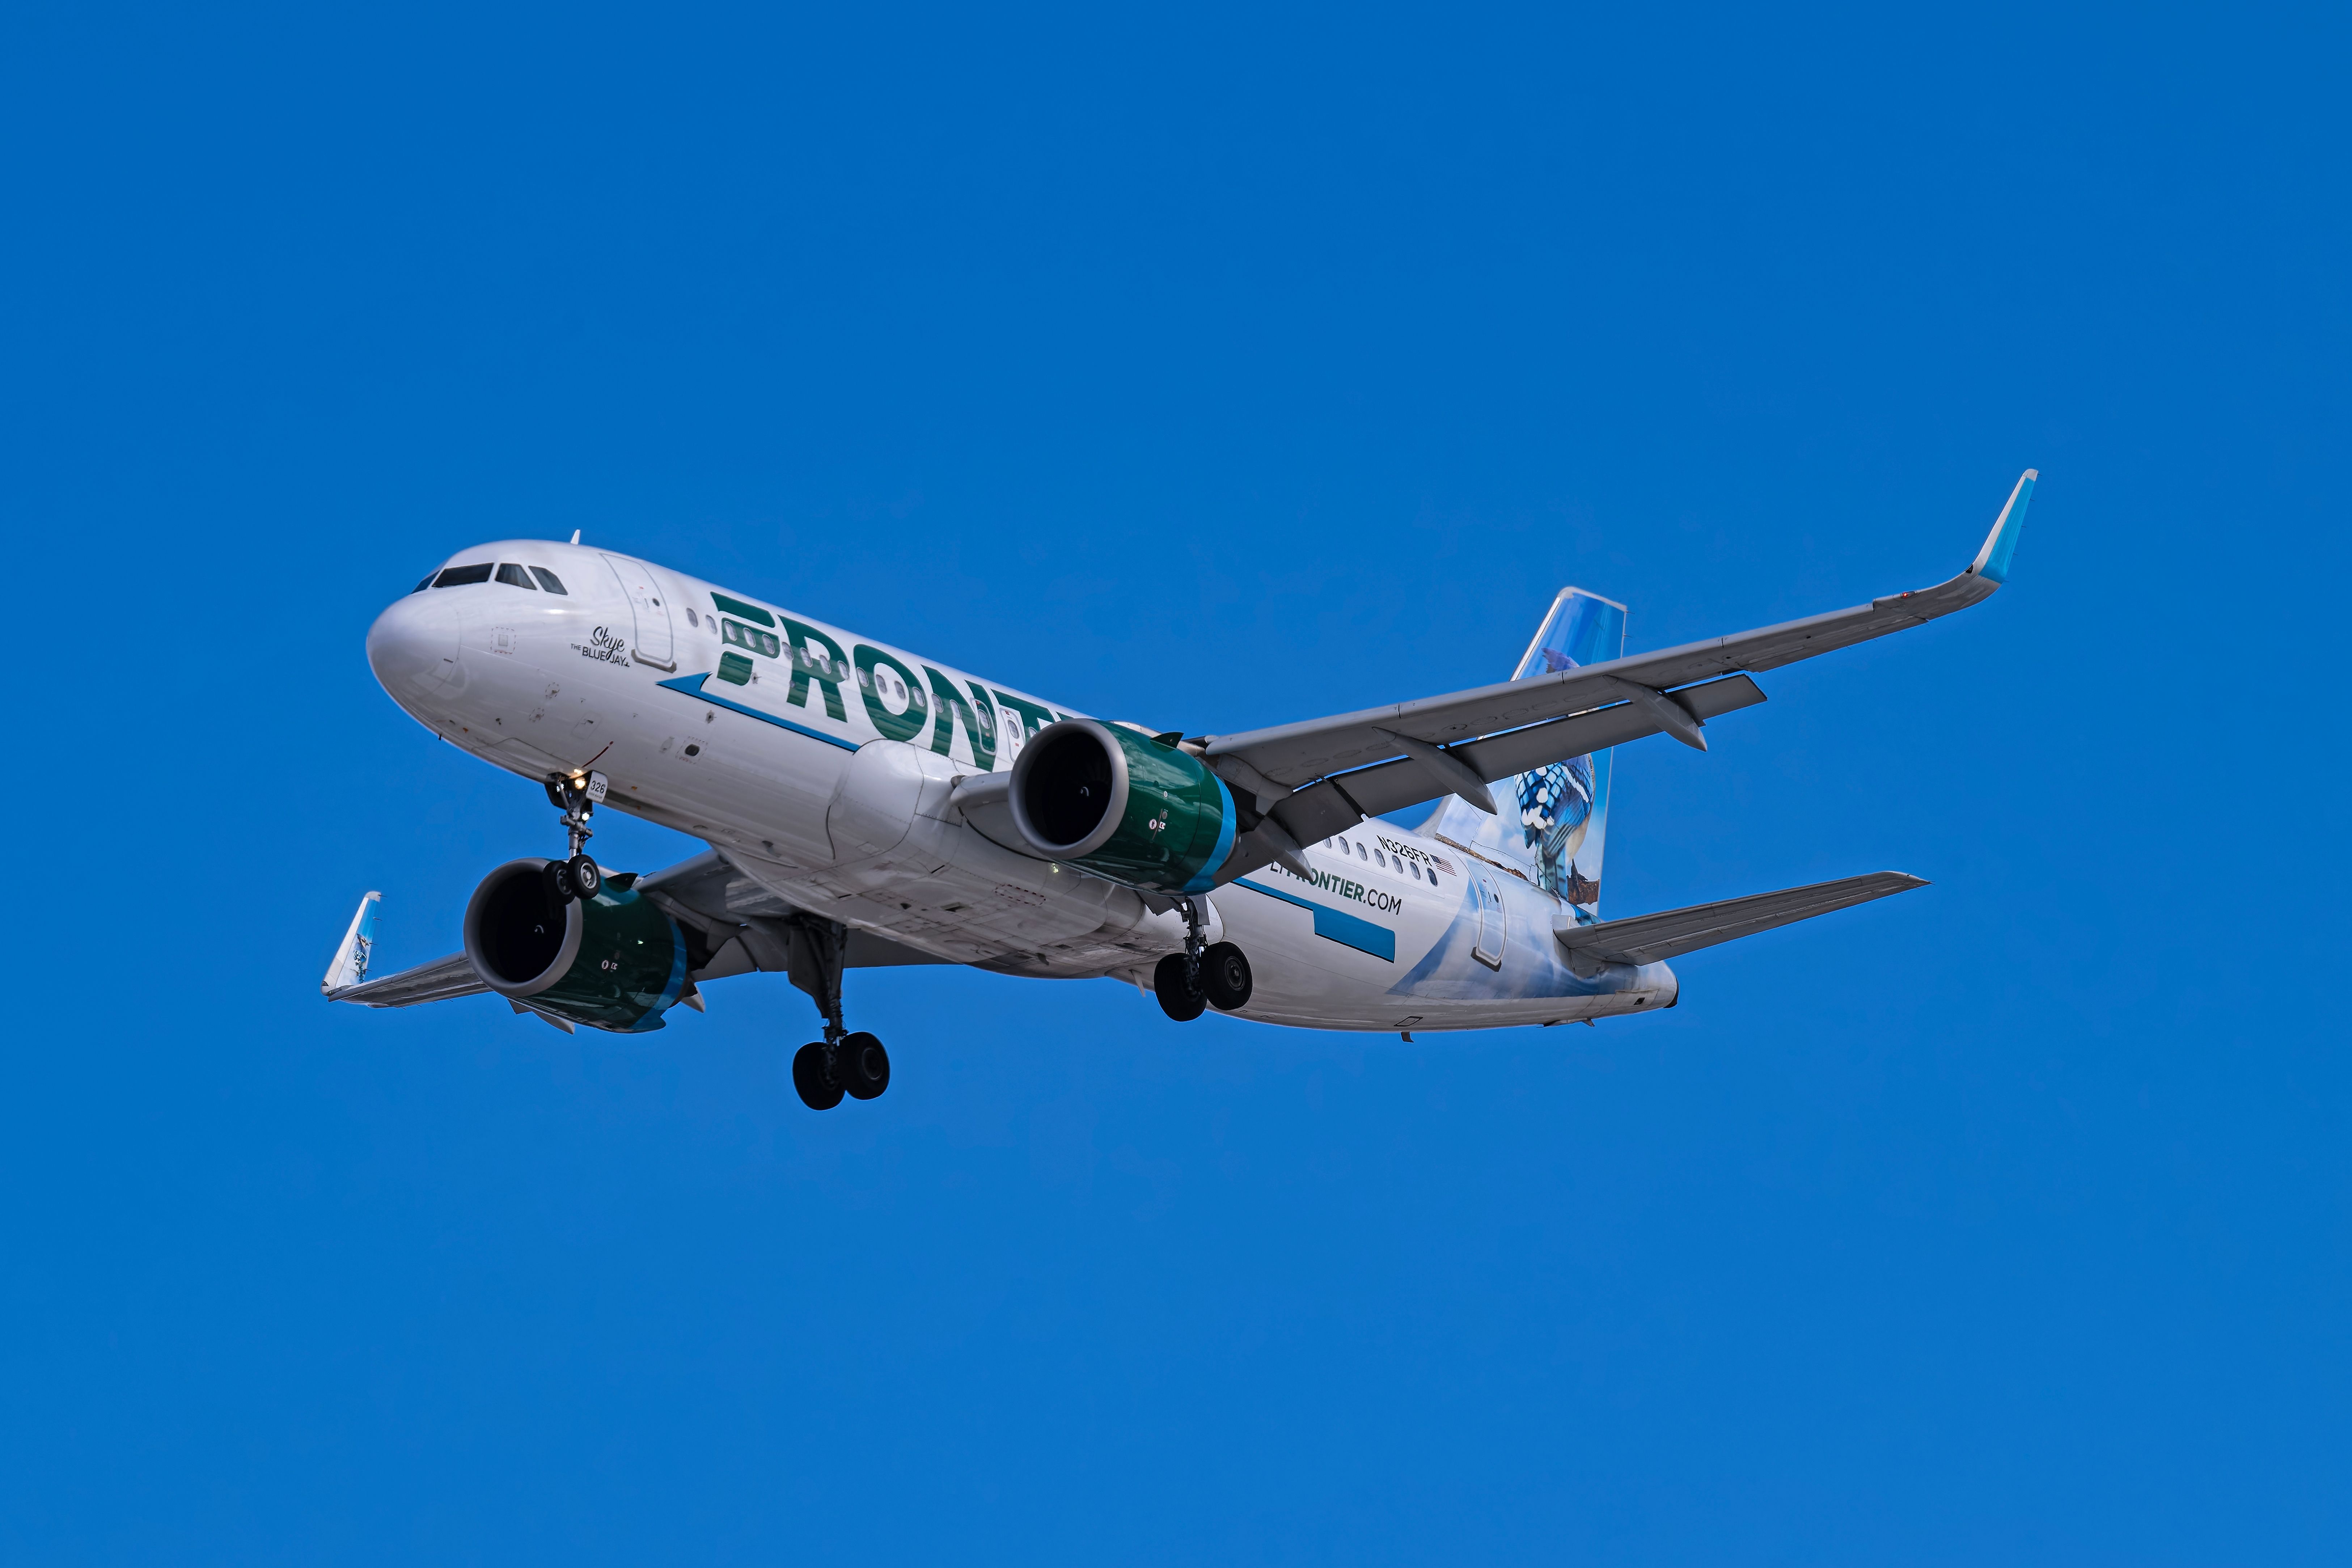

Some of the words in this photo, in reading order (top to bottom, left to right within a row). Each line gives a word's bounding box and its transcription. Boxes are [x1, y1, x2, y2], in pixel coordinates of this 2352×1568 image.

[582, 646, 606, 661] BLUE
[589, 626, 625, 660] Skye
[710, 591, 1074, 772] FRONT
[591, 780, 606, 793] 326
[1376, 835, 1433, 867] N326FR
[1270, 862, 1402, 915] LONTIER.COM
